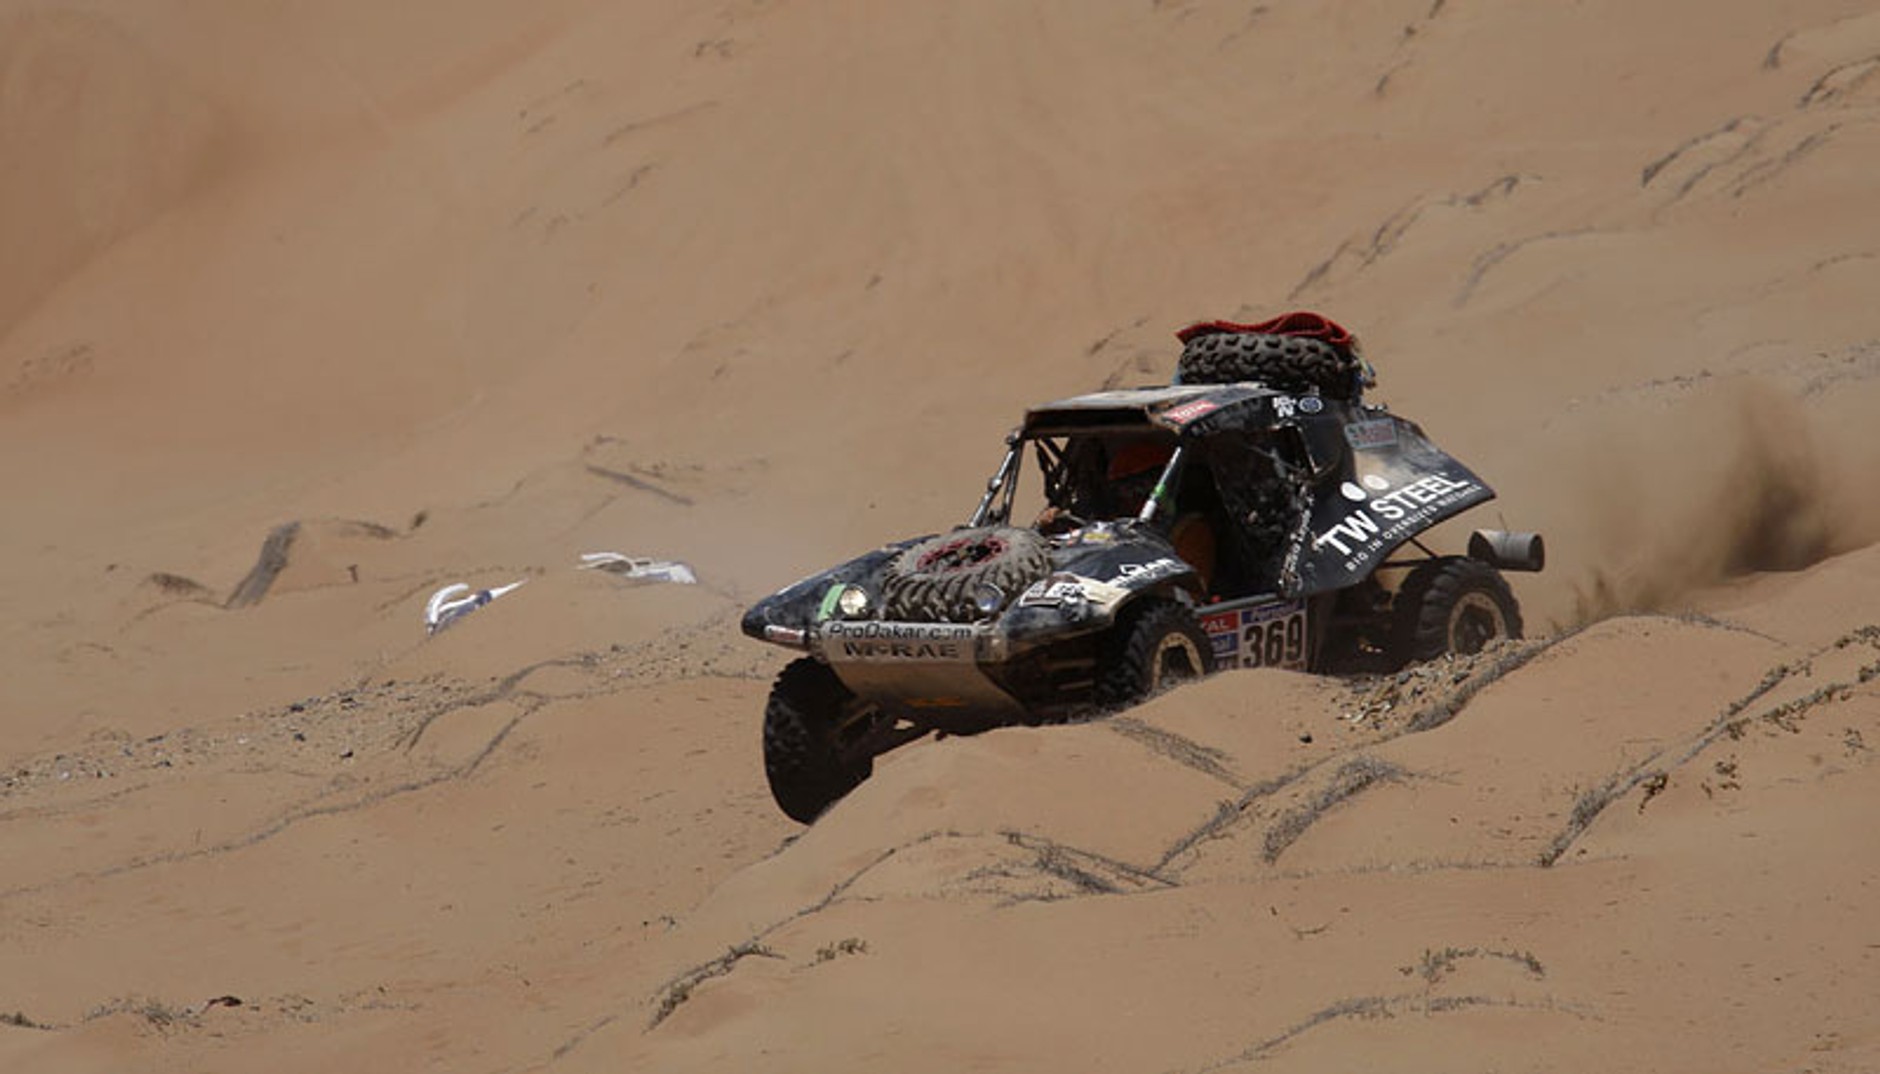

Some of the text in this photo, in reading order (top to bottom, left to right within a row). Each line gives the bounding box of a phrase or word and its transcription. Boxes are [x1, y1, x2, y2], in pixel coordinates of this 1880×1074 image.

[1315, 509, 1379, 556] TW
[1369, 472, 1470, 519] STEEL
[1242, 614, 1303, 668] 369
